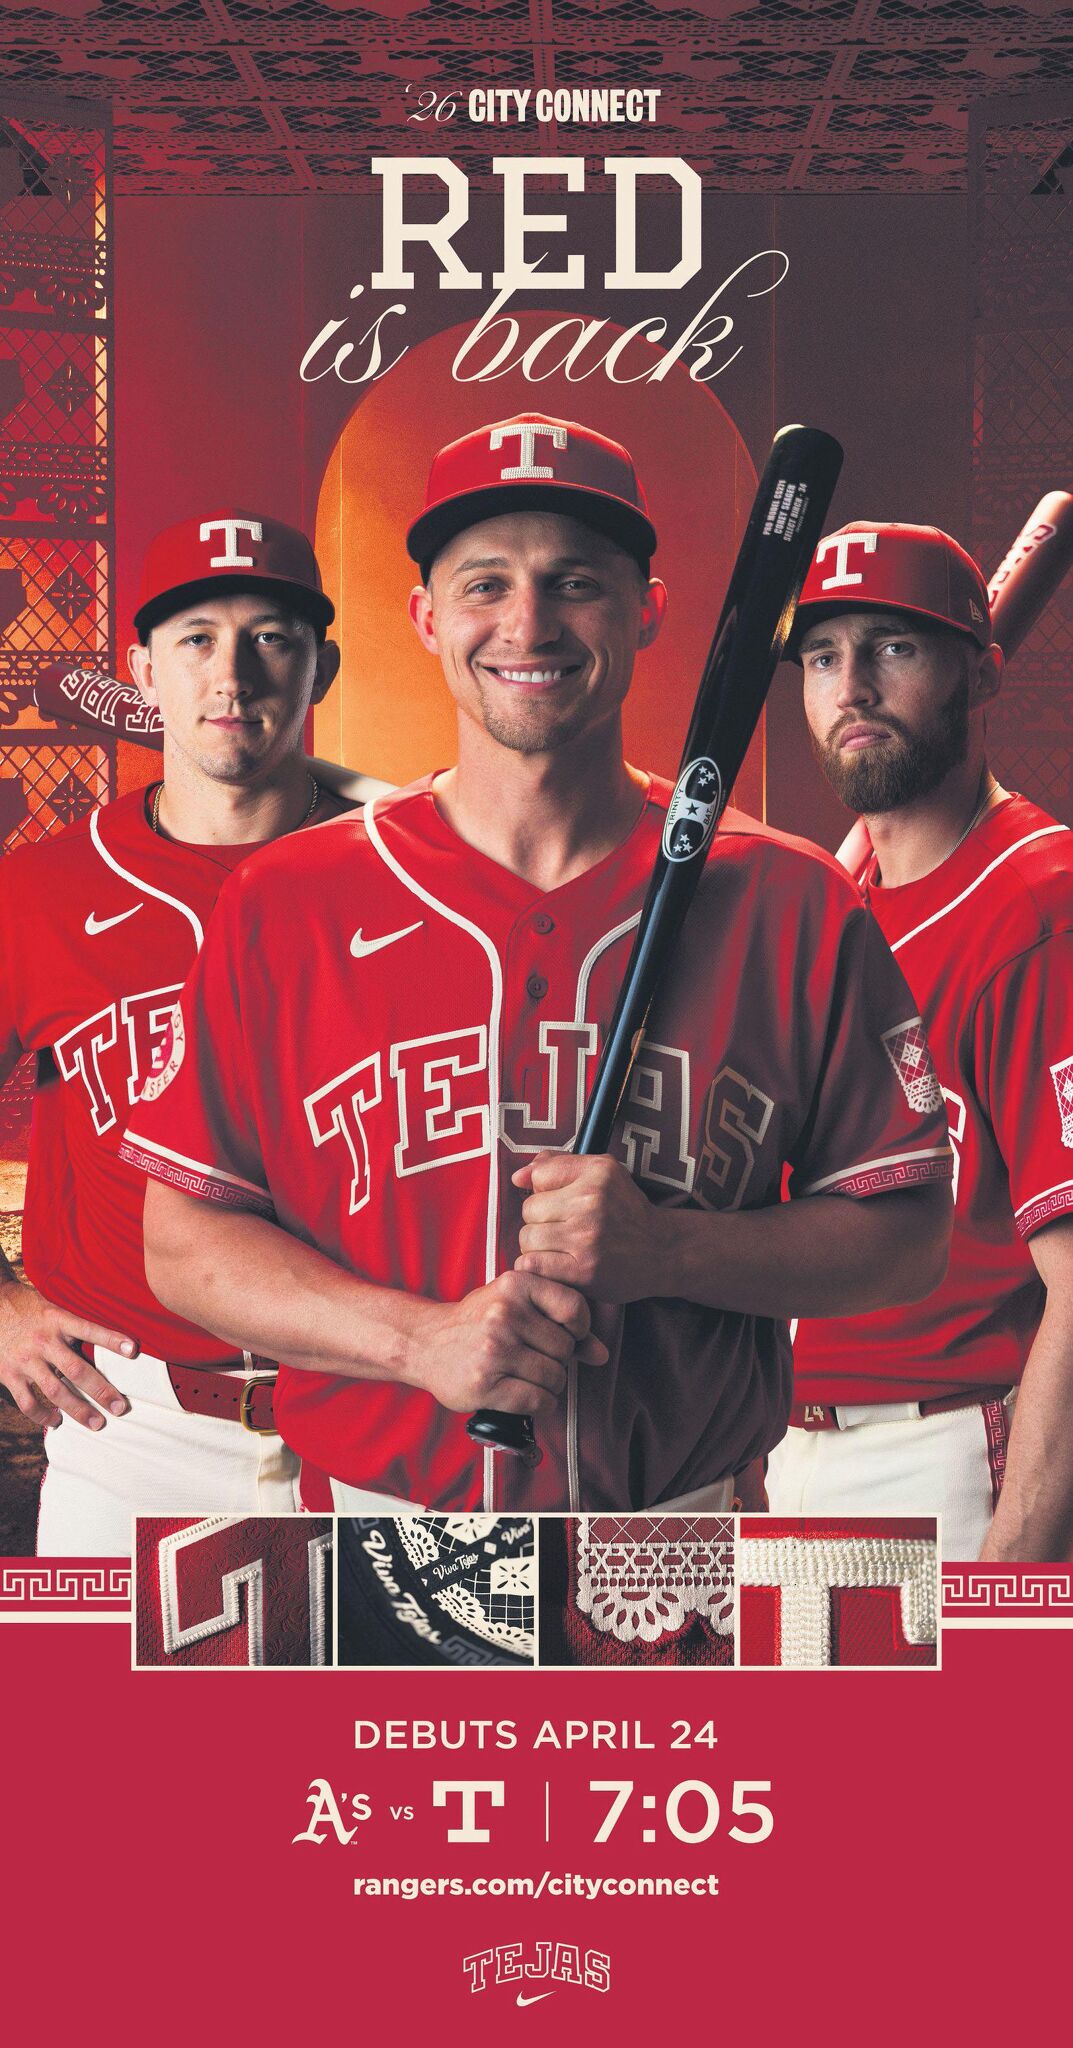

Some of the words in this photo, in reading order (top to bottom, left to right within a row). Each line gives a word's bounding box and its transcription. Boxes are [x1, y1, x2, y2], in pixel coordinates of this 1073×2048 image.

[489, 423, 568, 480] T
[767, 500, 780, 521] MODEL
[780, 484, 797, 511] SEAGER
[762, 521, 773, 535] PRO
[773, 511, 788, 535] COREY
[199, 519, 262, 568] T
[815, 531, 879, 591] T
[668, 788, 684, 826] TRINITY
[303, 1020, 776, 1214] TEJAS
[432, 1562, 459, 1580] Viva
